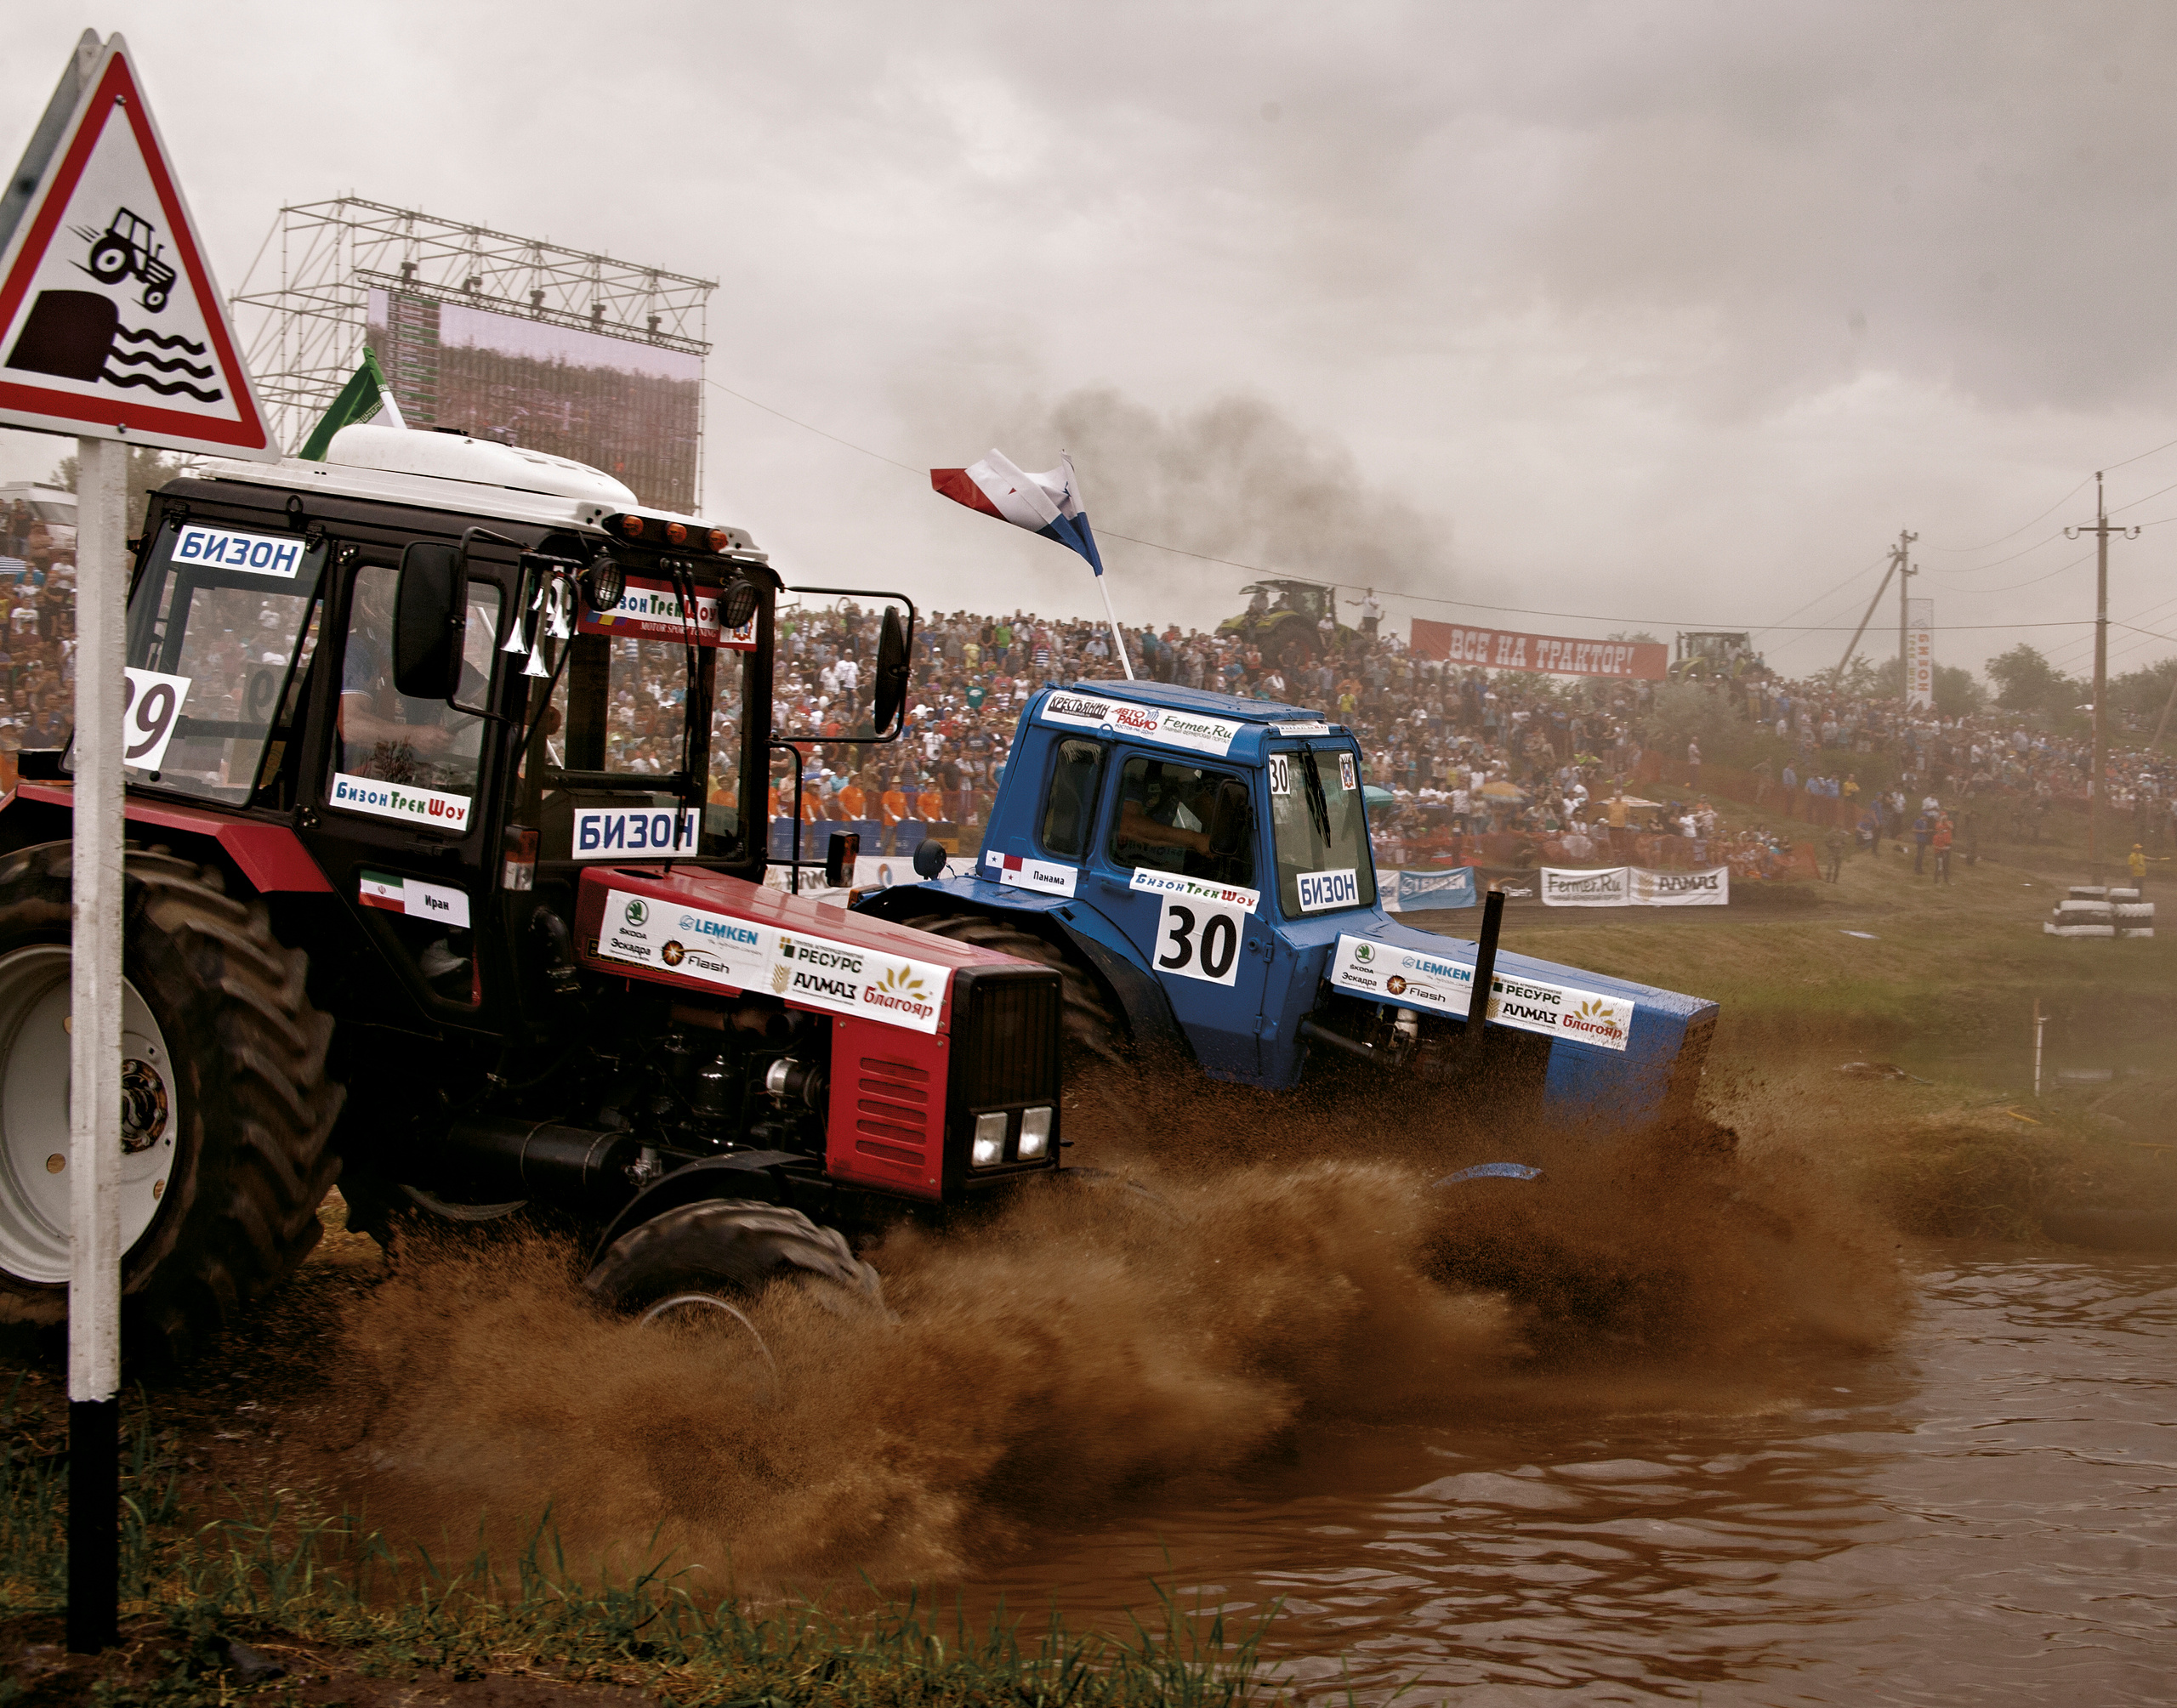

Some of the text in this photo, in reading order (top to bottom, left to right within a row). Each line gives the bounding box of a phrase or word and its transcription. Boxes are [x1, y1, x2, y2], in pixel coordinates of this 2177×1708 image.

[179, 531, 298, 572] БИЗОН
[640, 621, 668, 633] MOTOR
[1449, 628, 1635, 674] ВСЕ НА ТРАКТОР!
[1048, 695, 1111, 719] КРЕСТЬЯНИН
[1111, 706, 1145, 718] АВТО
[1116, 714, 1158, 731] РАДИО
[1163, 714, 1234, 740] Fermer.Ru
[1270, 759, 1288, 792] 30
[579, 814, 694, 850] БИЗОН
[1033, 870, 1066, 886] Панама
[1299, 873, 1357, 906] БИЗОН
[1547, 873, 1622, 893] Fermer.Ru
[1659, 875, 1719, 890] АЛМАЗ
[425, 894, 450, 911] Иран
[619, 926, 648, 940] ŠKODA
[695, 918, 759, 945] LEMKEN
[1158, 905, 1237, 979] 30
[611, 938, 651, 957] Эскадра
[799, 947, 863, 974] РЕСУРС
[1349, 963, 1374, 974] ŠKODA
[1415, 959, 1471, 982] LEMKEN
[793, 971, 859, 1000] АЛМАЗ
[1341, 972, 1378, 989] Эскадра
[863, 985, 935, 1020] Благояр
[1506, 985, 1561, 1005] РЕСУРС
[1503, 1002, 1557, 1024] АЛМАЗ
[1562, 1013, 1623, 1041] Благояр
